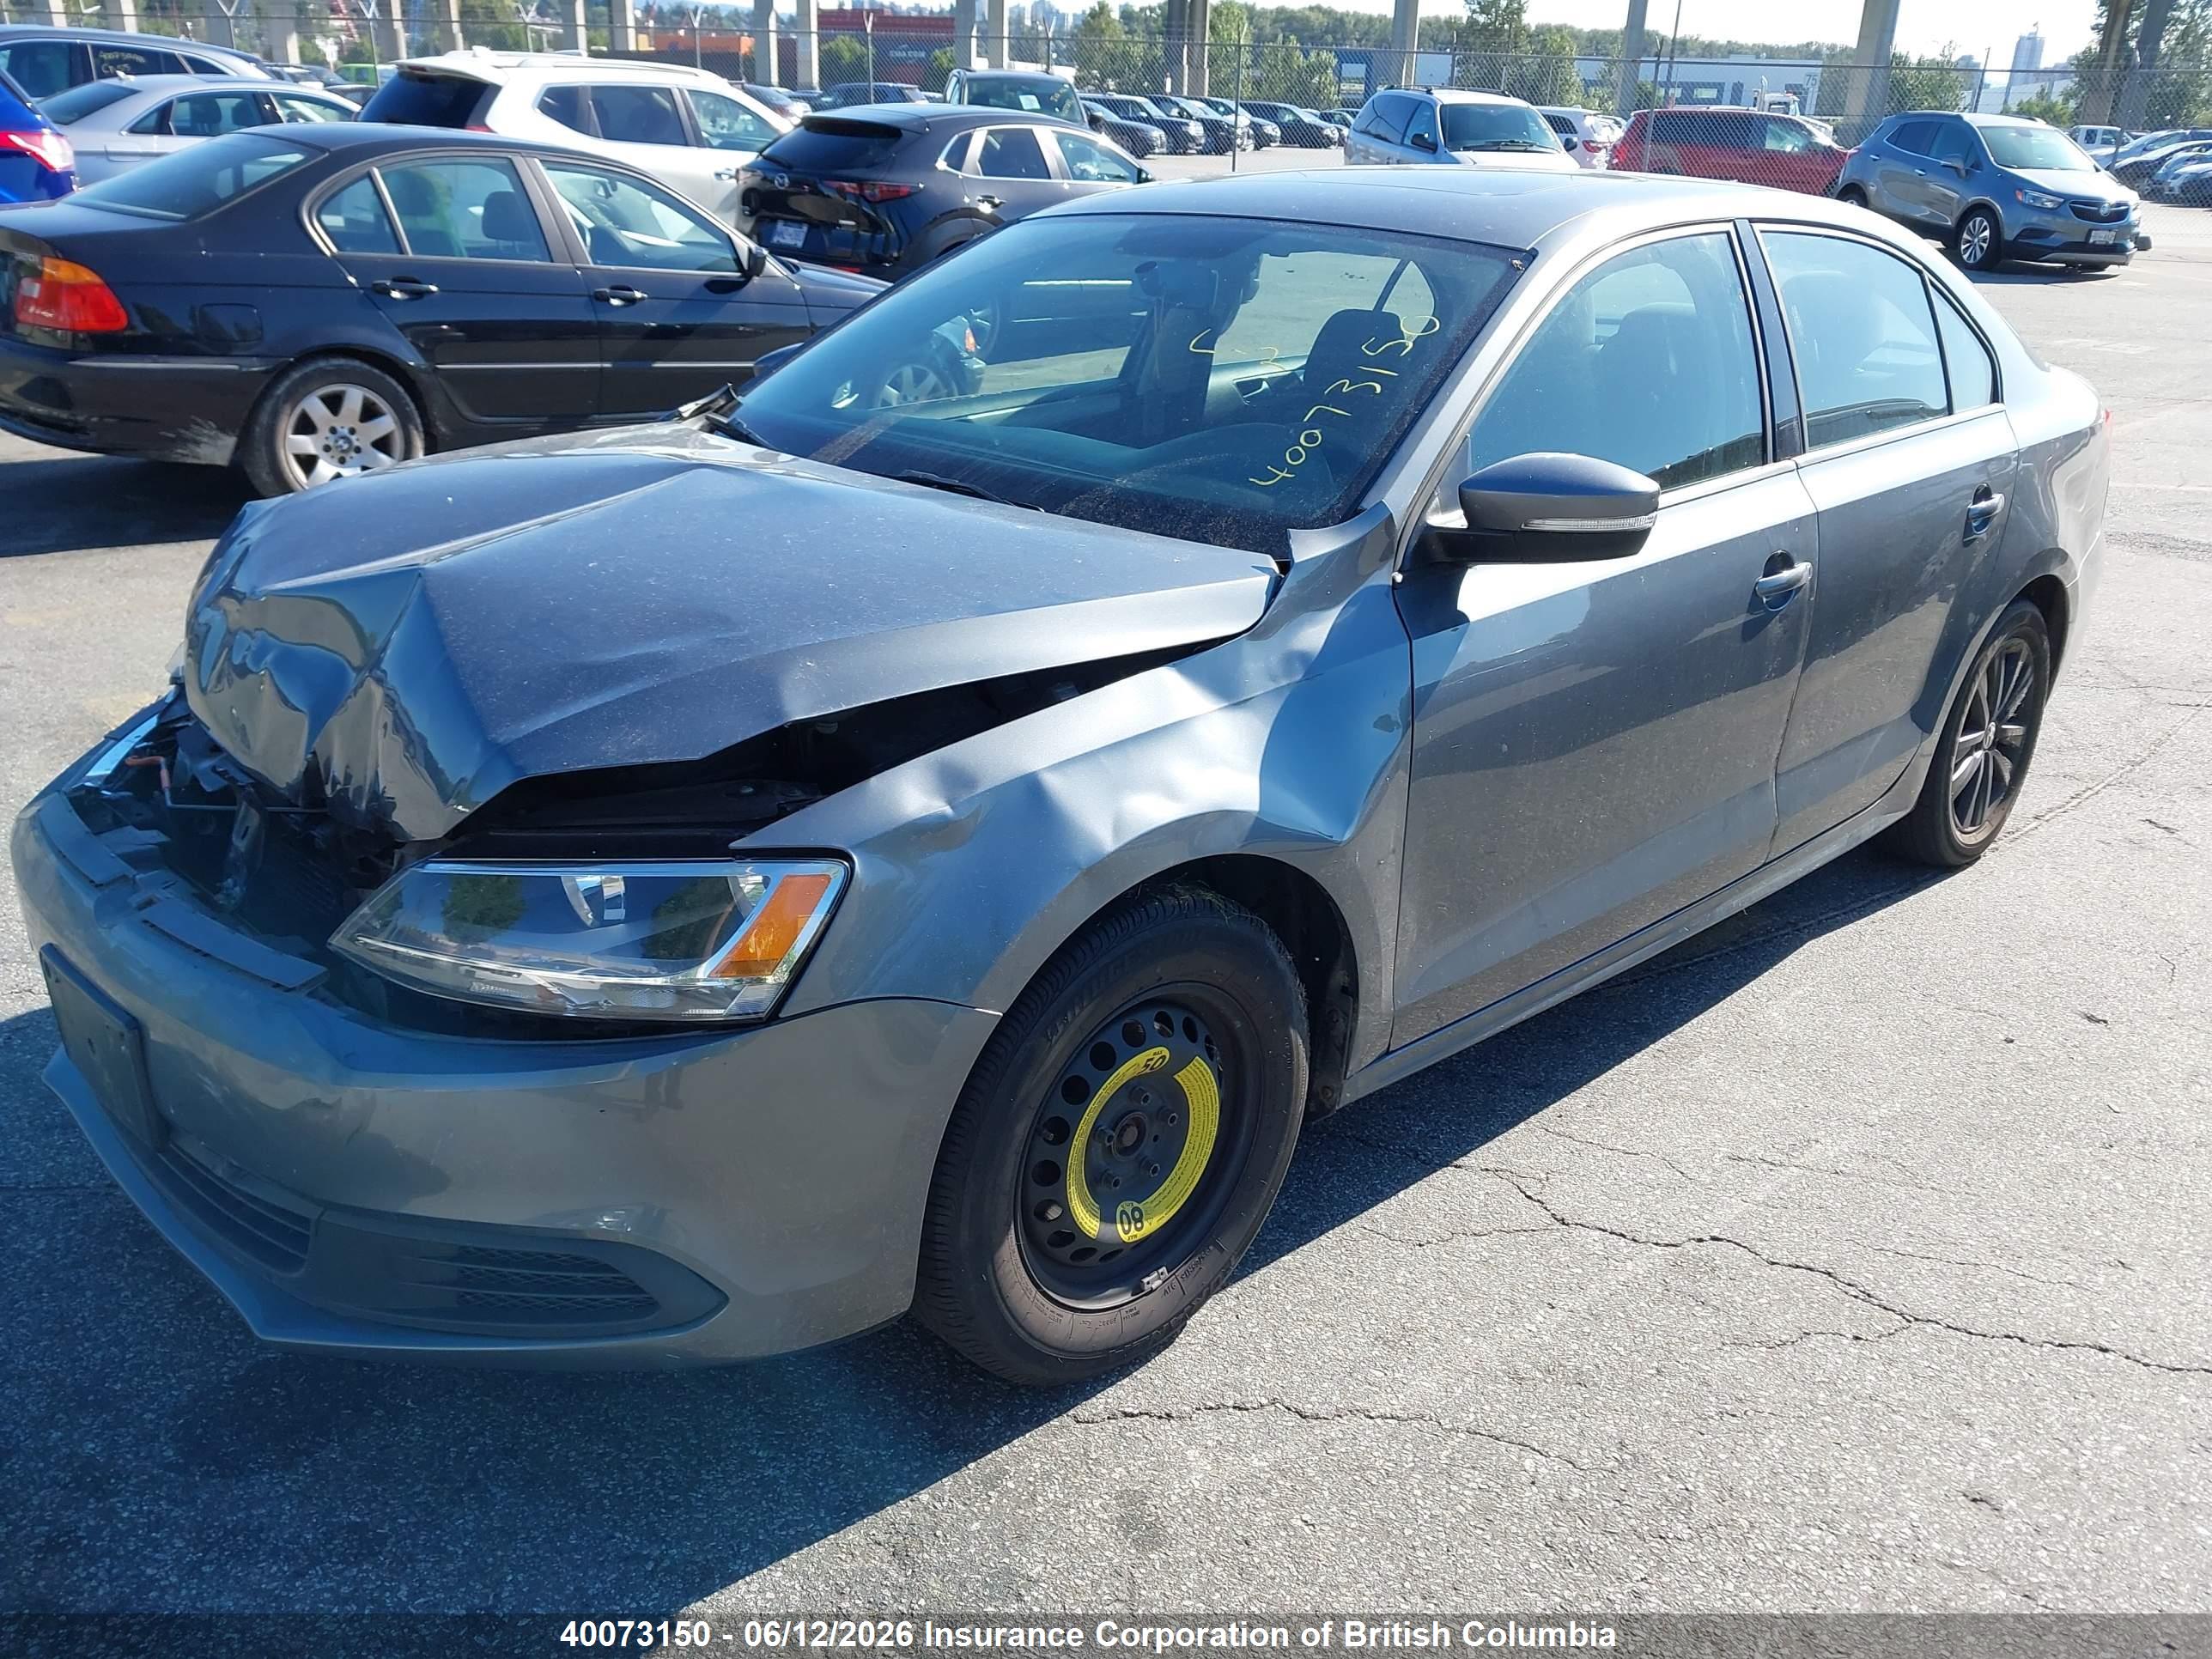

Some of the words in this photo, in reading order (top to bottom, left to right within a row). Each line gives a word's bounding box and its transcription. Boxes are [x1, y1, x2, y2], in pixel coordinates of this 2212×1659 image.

[1806, 74, 1819, 87] 75
[1248, 314, 1441, 488] 40073150
[1136, 1054, 1167, 1076] 50
[1119, 1206, 1145, 1236] 80
